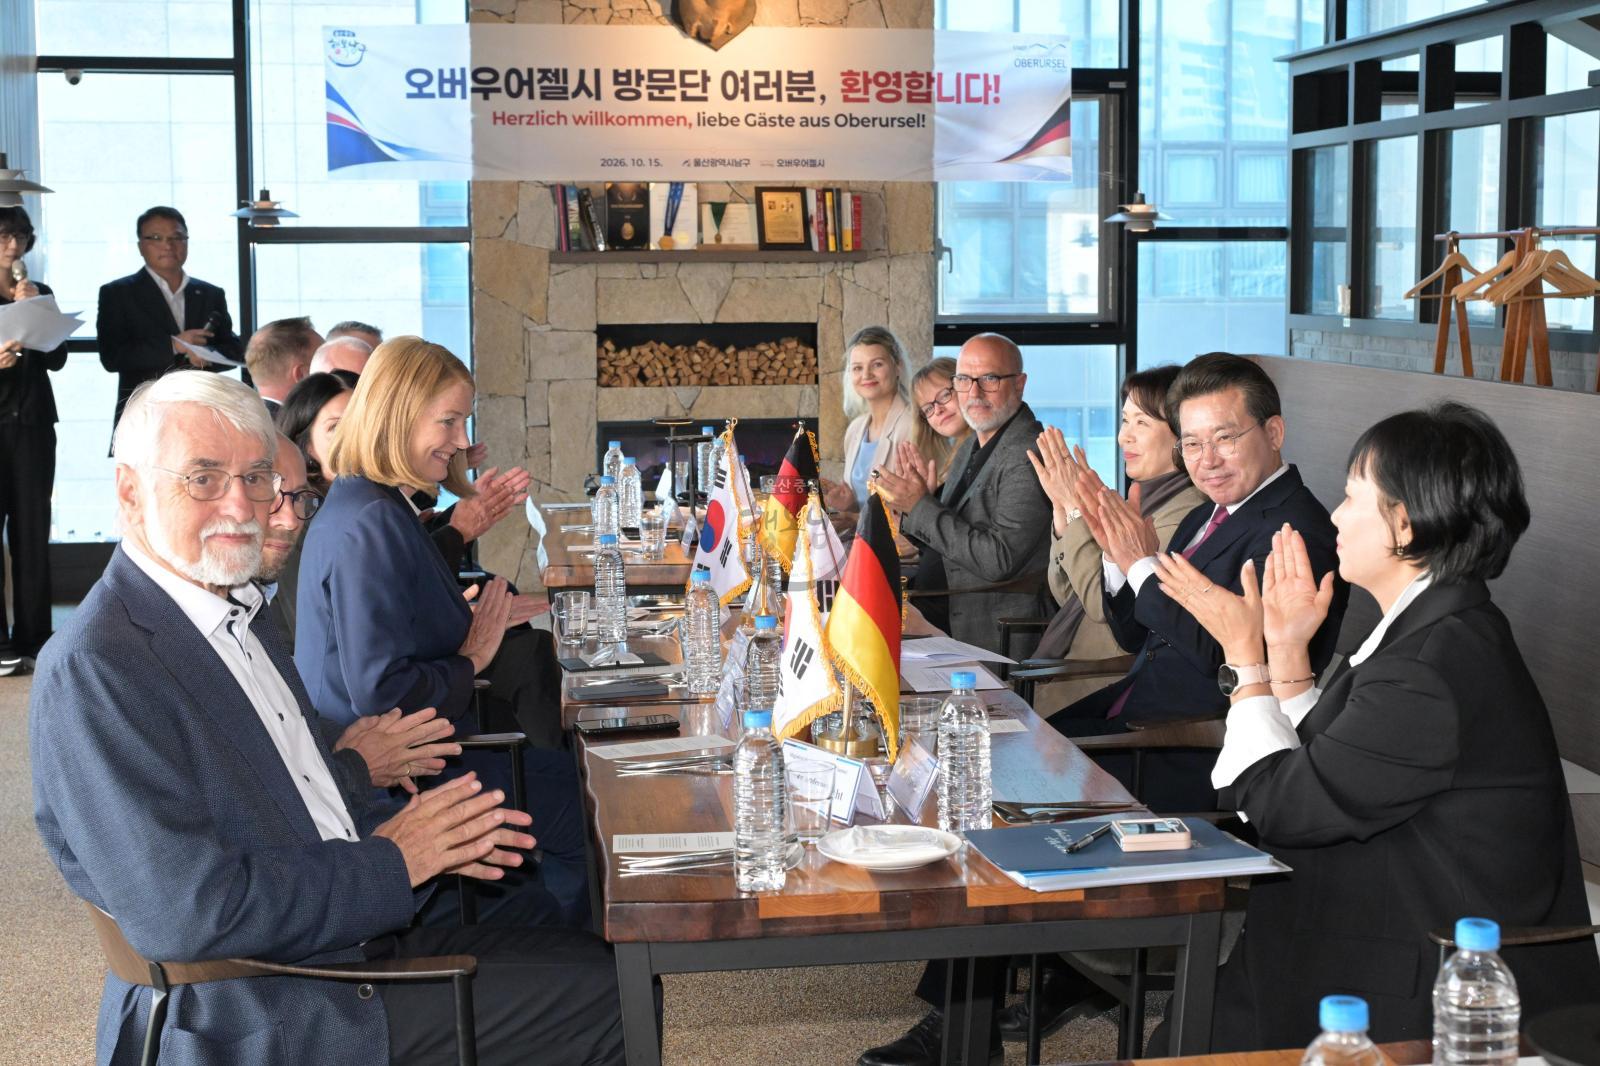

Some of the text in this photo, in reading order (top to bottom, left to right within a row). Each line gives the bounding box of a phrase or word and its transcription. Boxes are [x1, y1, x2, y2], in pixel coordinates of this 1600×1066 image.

[1014, 57, 1067, 69] OBERURSEL
[405, 66, 1001, 106] 오버우어젤시 방문단 여러분, 환영합니다!
[492, 109, 926, 130] Herzlich willkommen, liebe Gäste aus Oberursel!
[600, 157, 663, 168] 2026. 10. 15.
